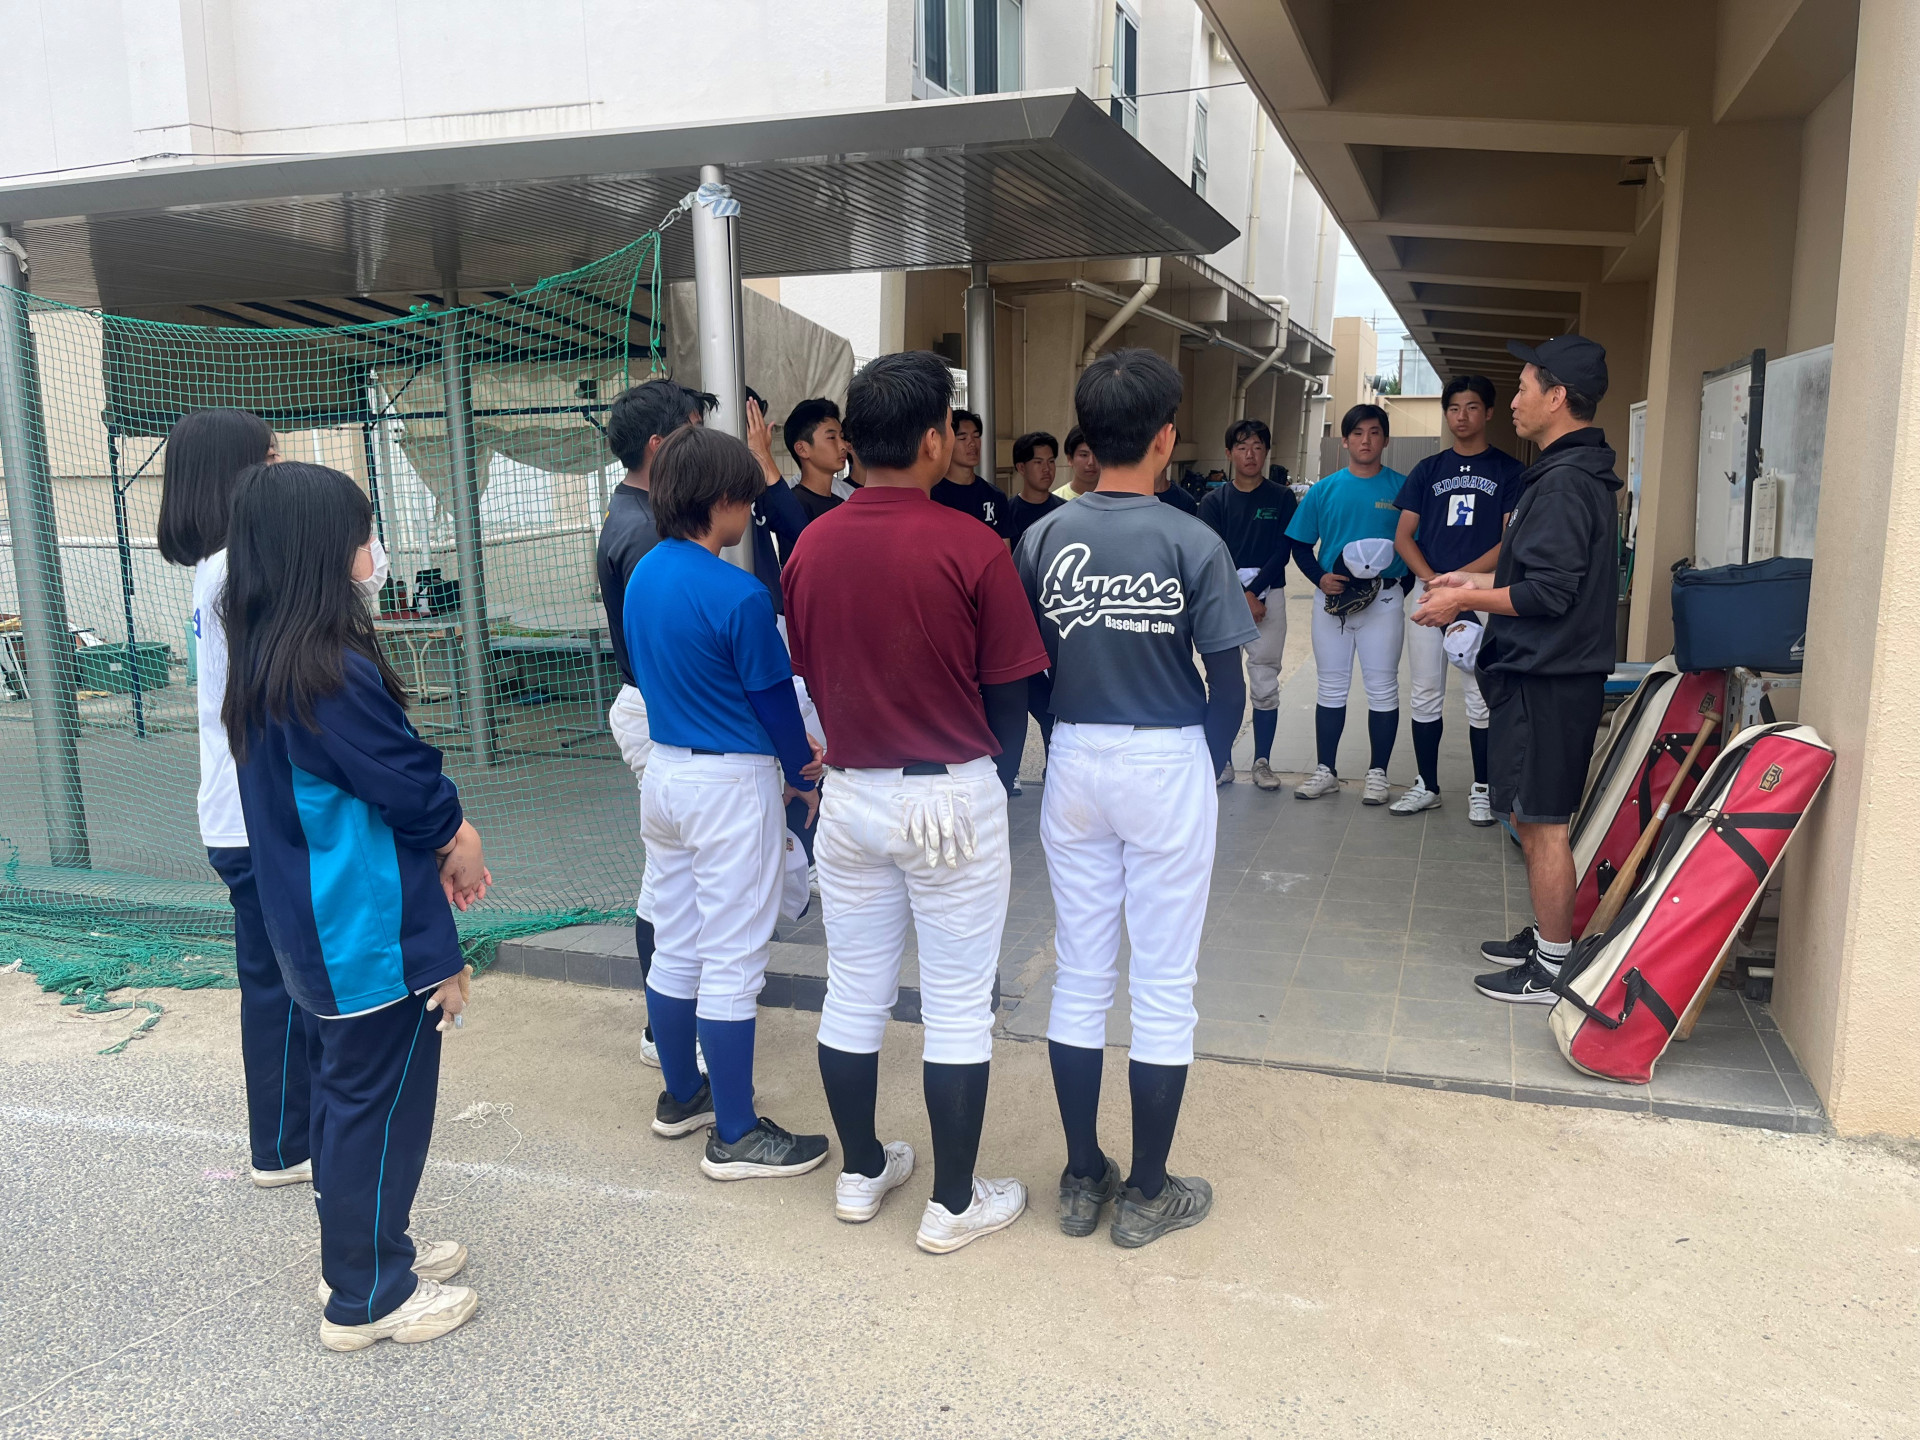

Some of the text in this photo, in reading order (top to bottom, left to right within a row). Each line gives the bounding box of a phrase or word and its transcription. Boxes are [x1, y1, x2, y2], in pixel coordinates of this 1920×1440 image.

[1432, 475, 1498, 496] EDOGAWA
[1039, 542, 1185, 640] Ayase
[1105, 614, 1175, 635] Baseball club
[1761, 764, 1780, 790] ZETT
